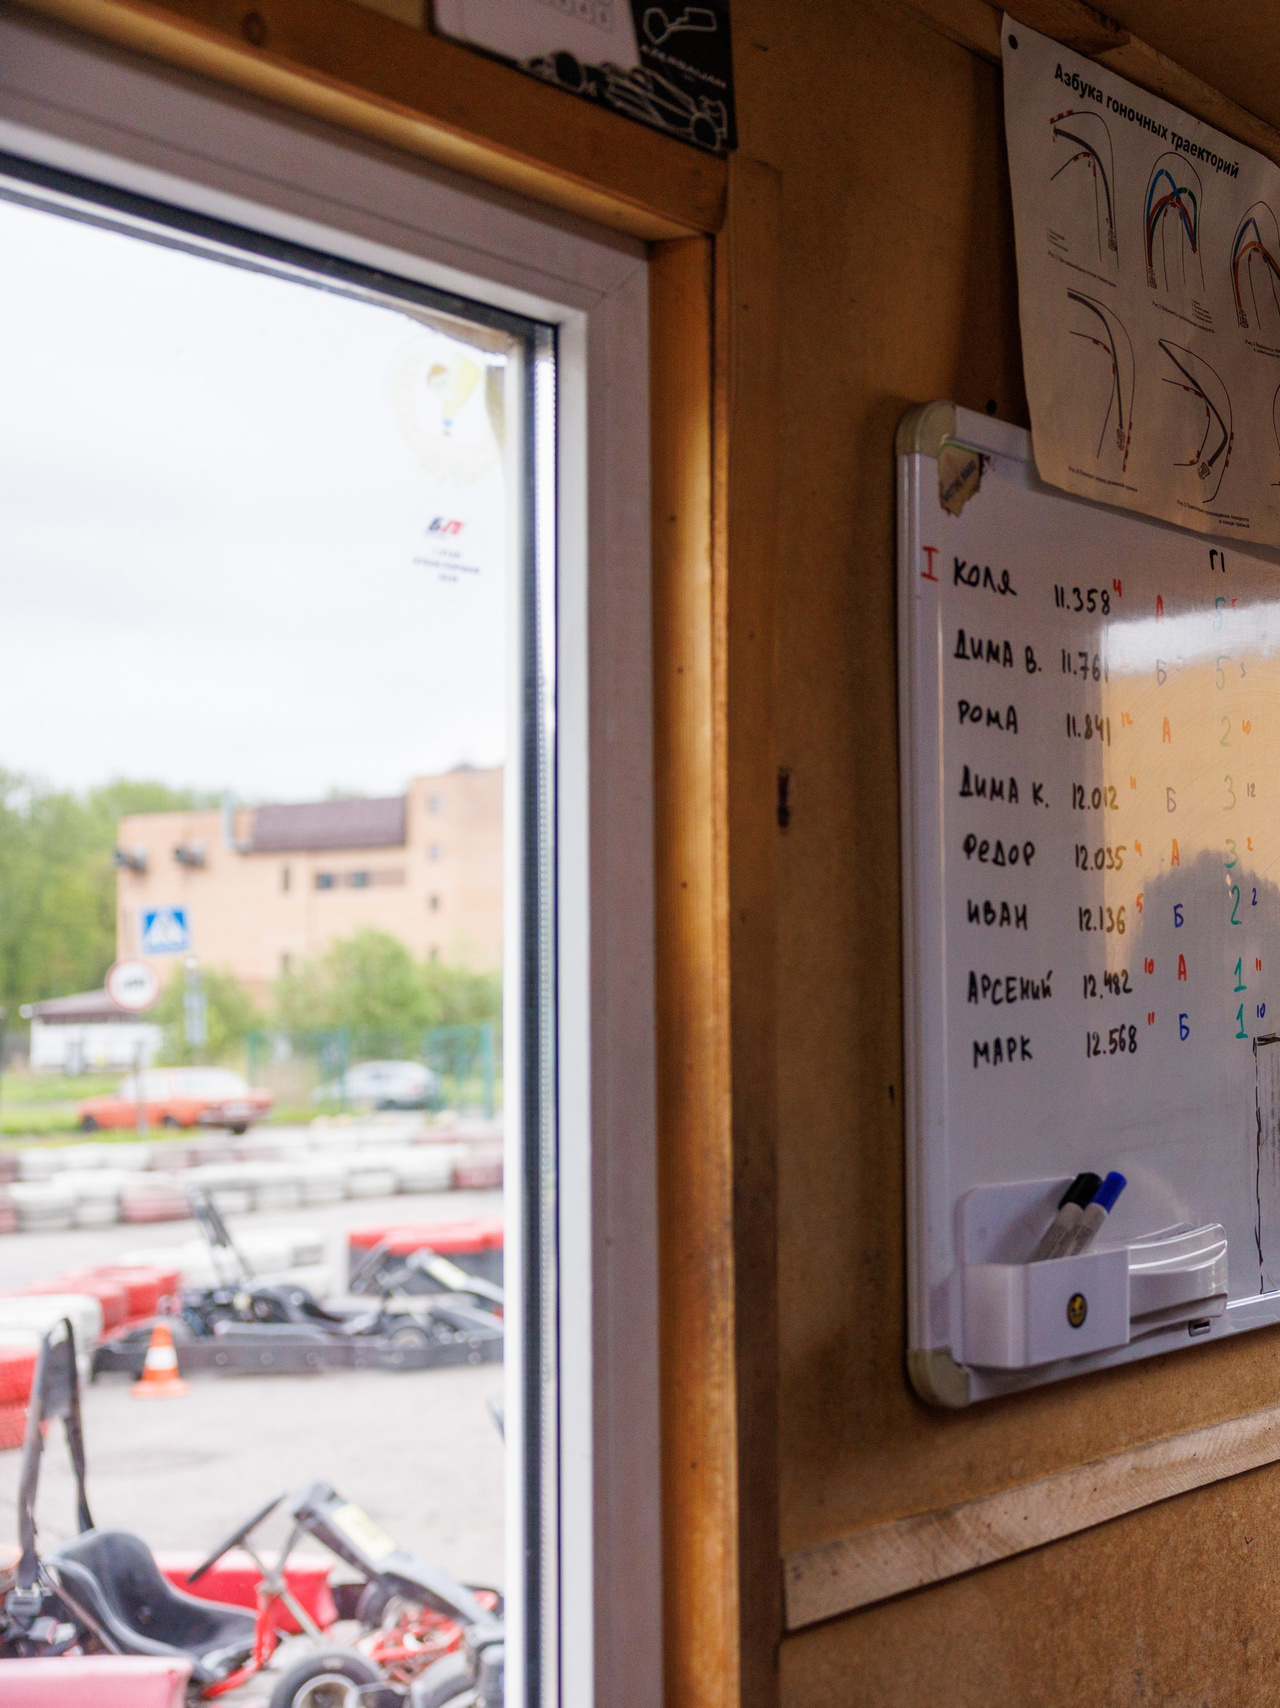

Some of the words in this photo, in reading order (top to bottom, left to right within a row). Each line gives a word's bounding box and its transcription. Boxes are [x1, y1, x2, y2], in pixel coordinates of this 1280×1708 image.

[1054, 63, 1103, 104] Азбука
[1106, 94, 1167, 140] гоночных
[1171, 131, 1239, 179] траекторий
[1054, 584, 1111, 616] 11.358
[954, 629, 1013, 668] ДИМА
[1215, 655, 1231, 691] 5
[958, 700, 1018, 735] РОМА
[1066, 711, 1112, 747] 11.841
[1219, 715, 1232, 747] 2
[959, 764, 1019, 804] ДИМА
[1072, 782, 1119, 811] 12.012
[1222, 774, 1238, 811] 3
[1075, 844, 1127, 871] 12.035
[1224, 838, 1238, 868] 3
[967, 899, 1028, 930] ИВАН
[1079, 905, 1126, 935] 12.136
[1174, 903, 1184, 928] Б
[1230, 885, 1242, 925] 2
[967, 970, 1053, 1005] АРСЕНИЙ
[1083, 969, 1133, 999] 12.482
[1177, 953, 1187, 981] А
[1234, 957, 1248, 992] 1
[973, 1034, 1033, 1069] МАРК
[1087, 1023, 1137, 1058] 12.568
[1178, 1013, 1190, 1041] Б
[1235, 1003, 1249, 1039] 1
